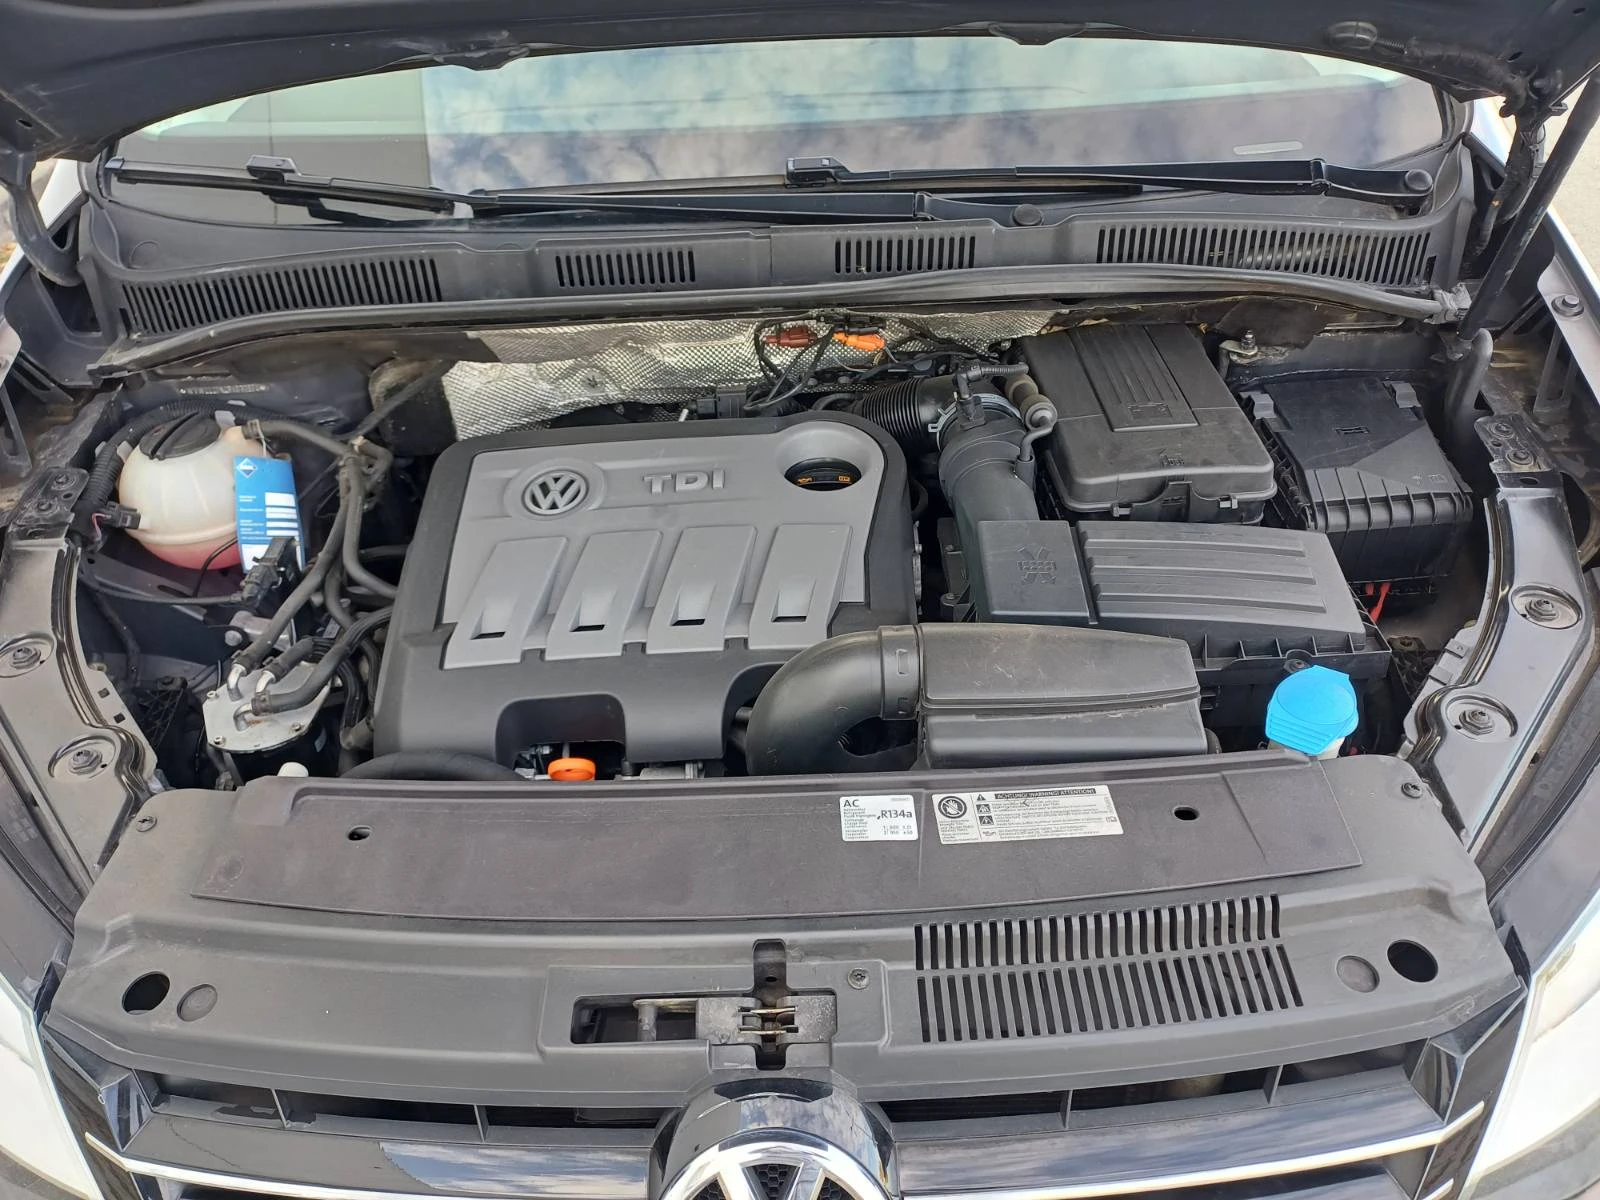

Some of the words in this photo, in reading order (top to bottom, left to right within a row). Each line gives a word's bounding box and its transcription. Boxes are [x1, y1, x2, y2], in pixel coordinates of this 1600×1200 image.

[643, 469, 726, 494] TDI
[525, 471, 587, 514] VW
[843, 799, 860, 808] AC
[881, 809, 913, 819] R134a
